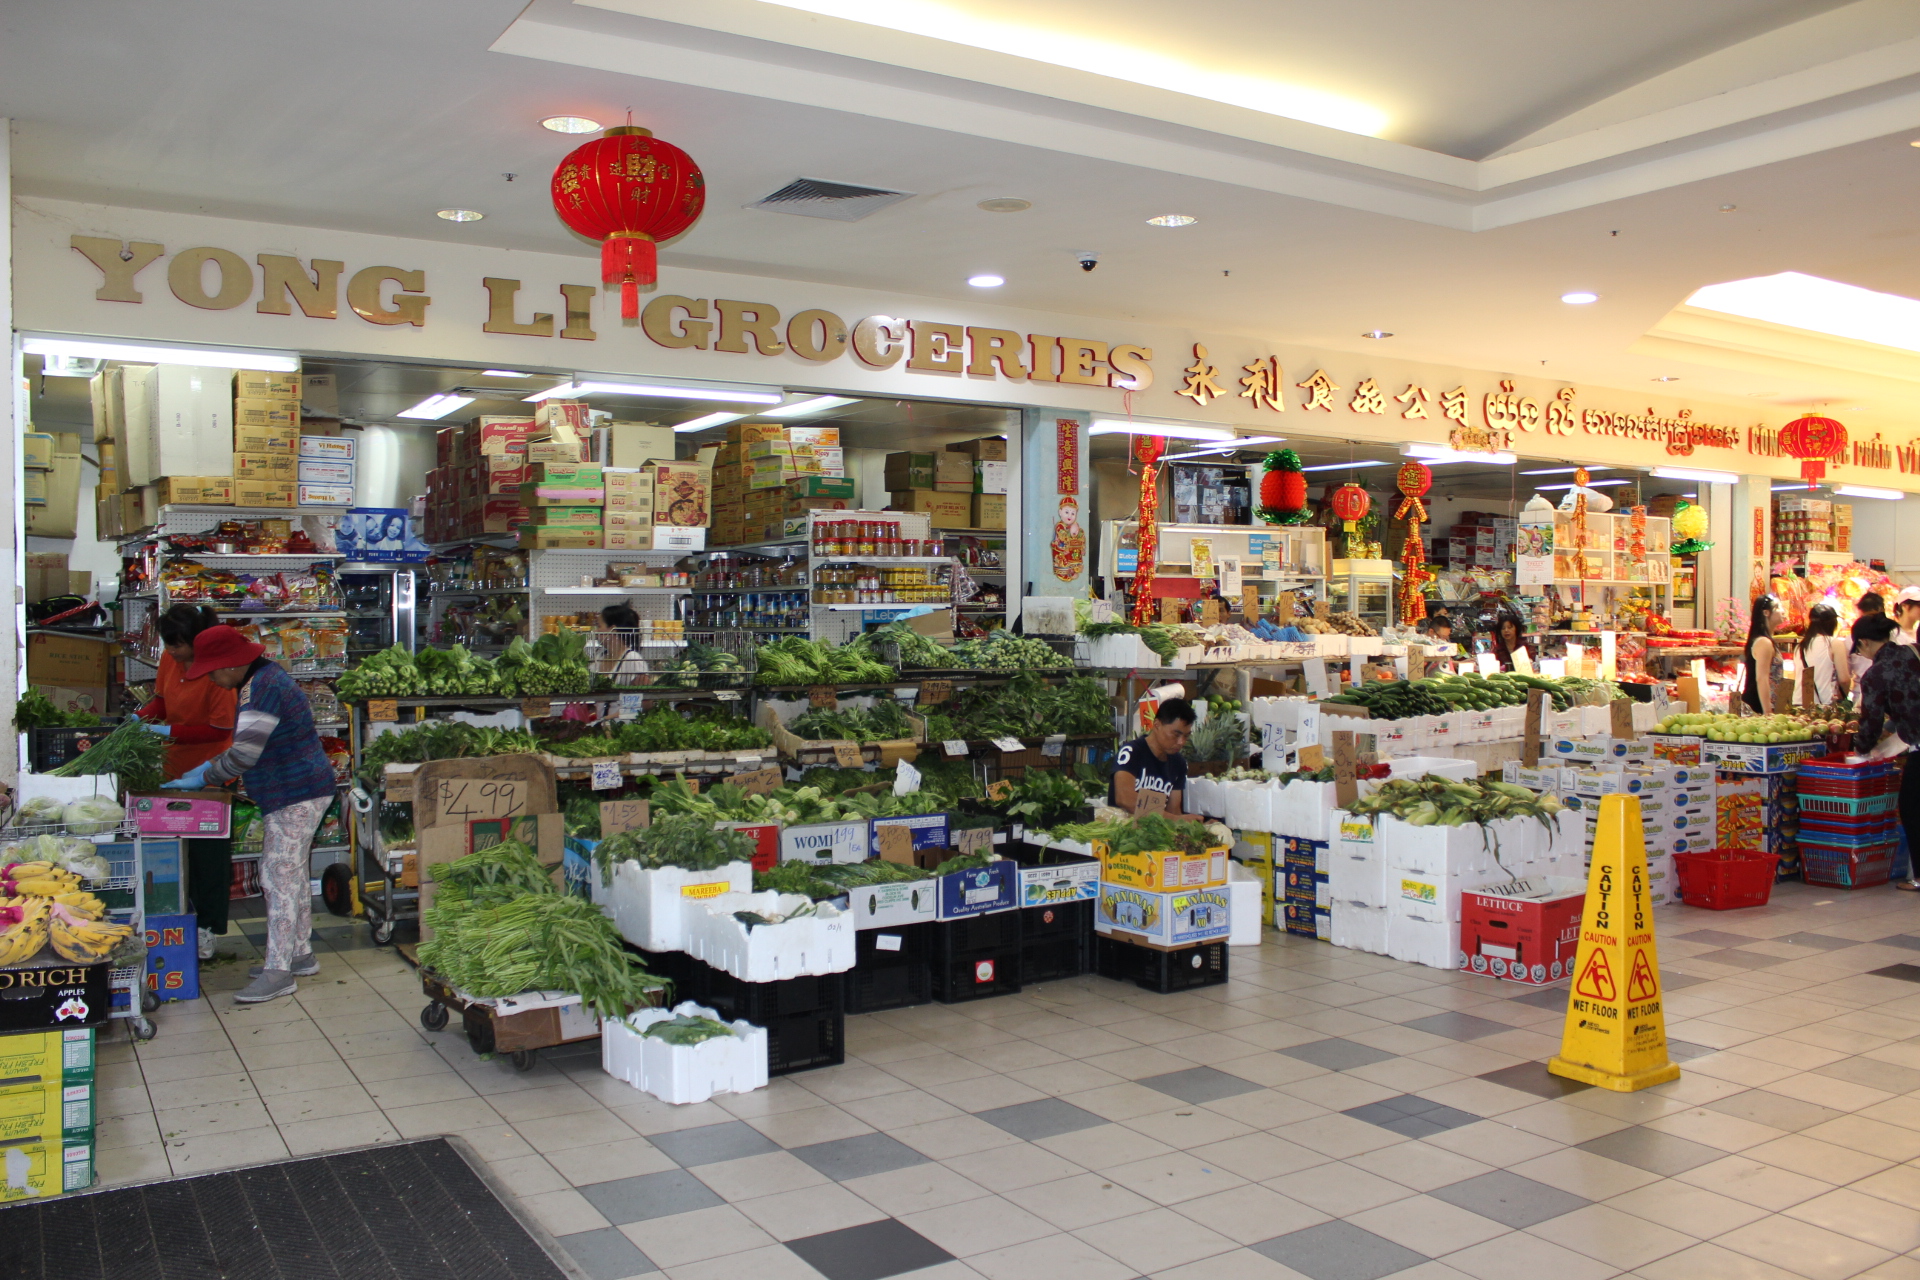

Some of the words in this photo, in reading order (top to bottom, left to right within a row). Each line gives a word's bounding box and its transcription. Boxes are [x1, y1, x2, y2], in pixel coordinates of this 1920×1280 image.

[70, 234, 431, 327] YONG
[482, 276, 597, 341] LI
[641, 294, 1154, 391] GROCERIES
[1175, 342, 1470, 427] 永利食品公司
[1116, 745, 1133, 765] 6
[988, 868, 999, 876] Fresh
[688, 885, 722, 896] MAREEBA
[1046, 887, 1077, 900] APPLES
[1596, 865, 1612, 929] CAUTION
[1632, 865, 1644, 930] CAUTION
[952, 906, 970, 915] Quality
[970, 901, 993, 911] Australian
[1106, 891, 1154, 916] BANANAS
[1476, 896, 1523, 912] LETTUCE
[1584, 931, 1617, 946] CAUTION
[1627, 933, 1651, 947] CAUTION
[58, 988, 86, 997] APPLES
[1573, 999, 1589, 1012] WET
[1592, 1001, 1618, 1020] FLOOR
[1627, 1007, 1639, 1020] WET
[1641, 1002, 1660, 1017] FLOOR
